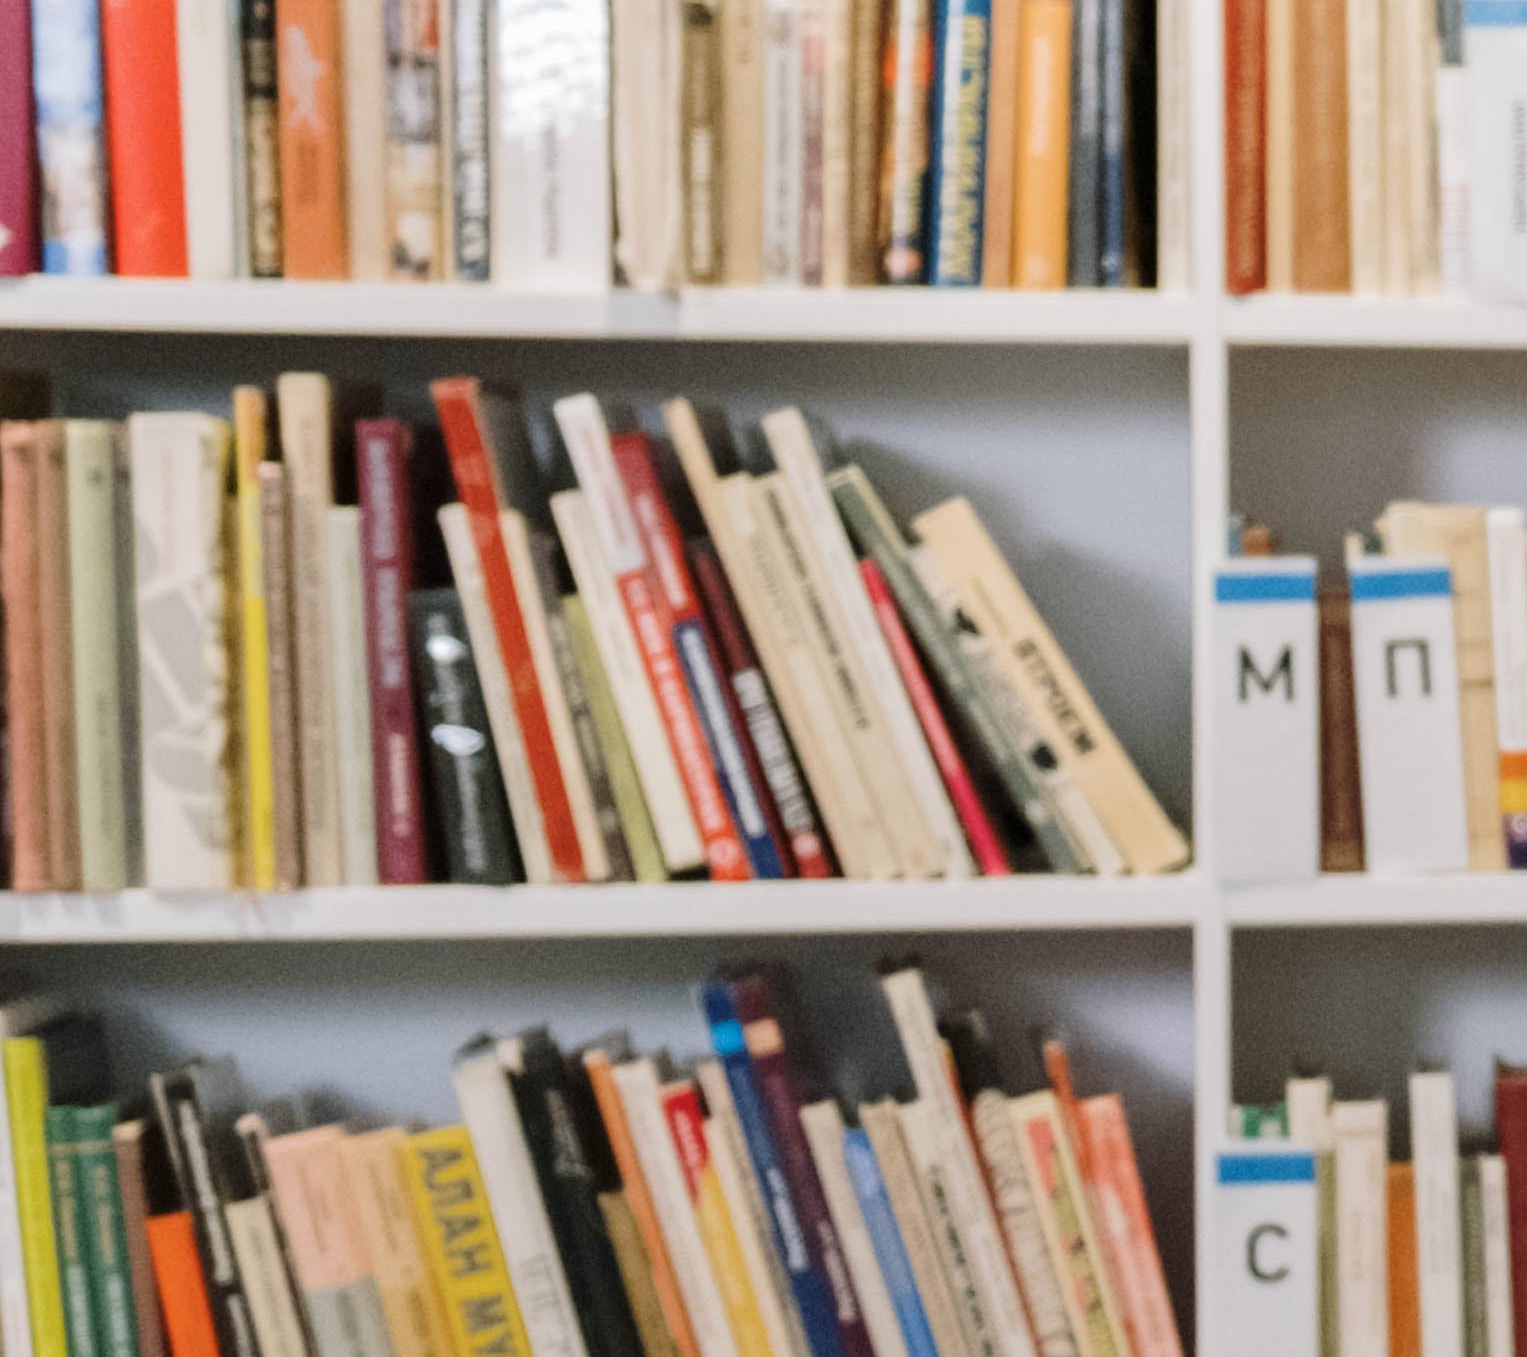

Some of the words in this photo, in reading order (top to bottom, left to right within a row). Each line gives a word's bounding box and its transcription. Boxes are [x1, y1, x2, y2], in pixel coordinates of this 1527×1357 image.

[1237, 639, 1296, 701] М
[1385, 641, 1434, 699] П
[419, 1147, 494, 1279] АЛАН
[1244, 1223, 1291, 1284] С
